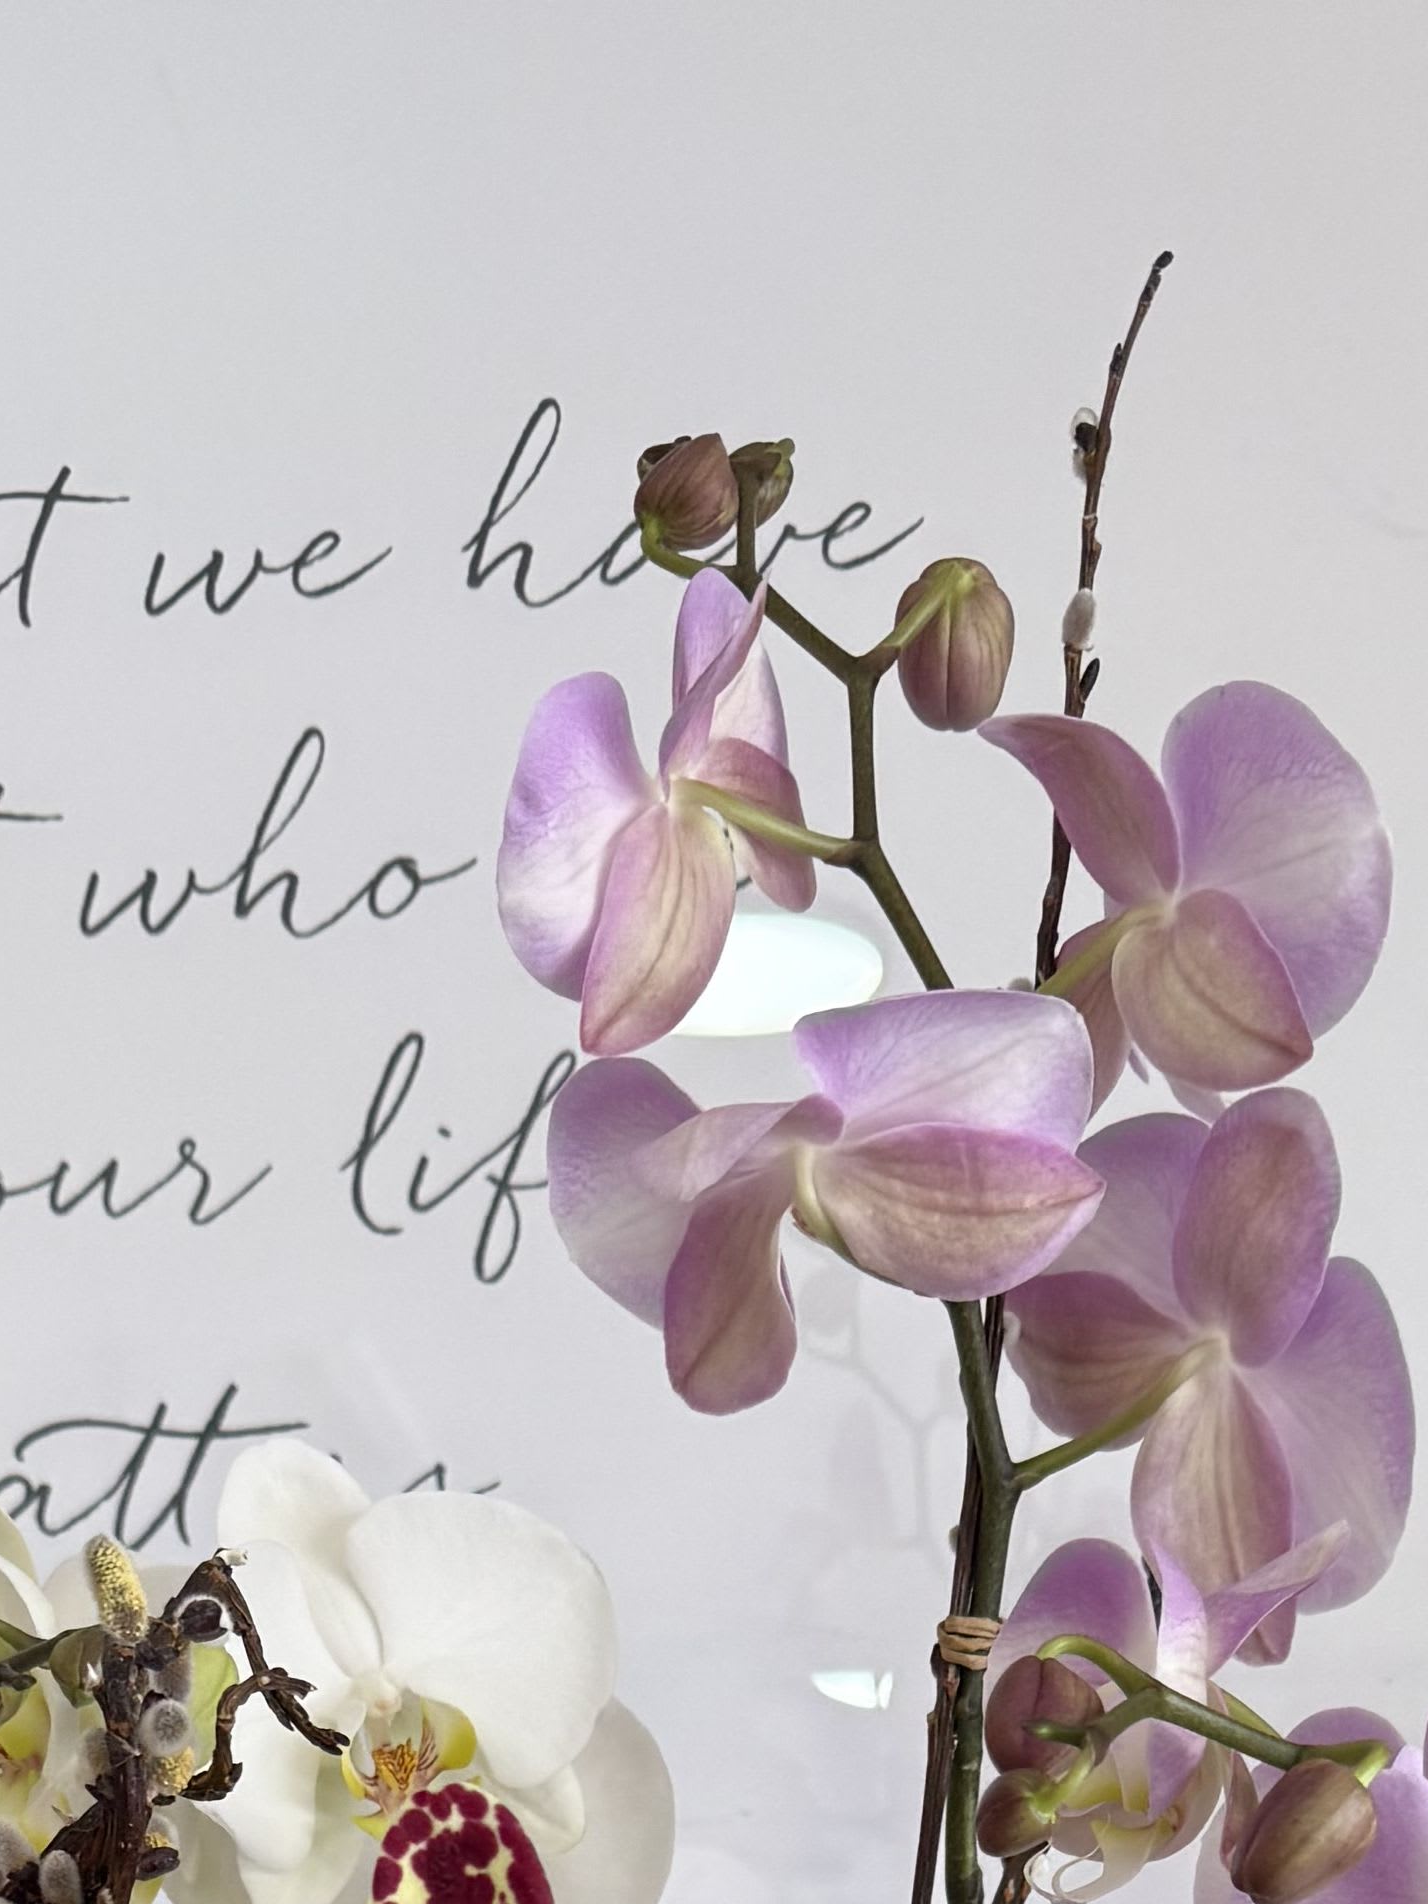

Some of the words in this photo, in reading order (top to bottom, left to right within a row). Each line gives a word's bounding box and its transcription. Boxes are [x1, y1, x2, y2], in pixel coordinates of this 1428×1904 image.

[144, 530, 392, 617] we
[79, 726, 477, 939] who
[340, 1031, 577, 1284] lif
